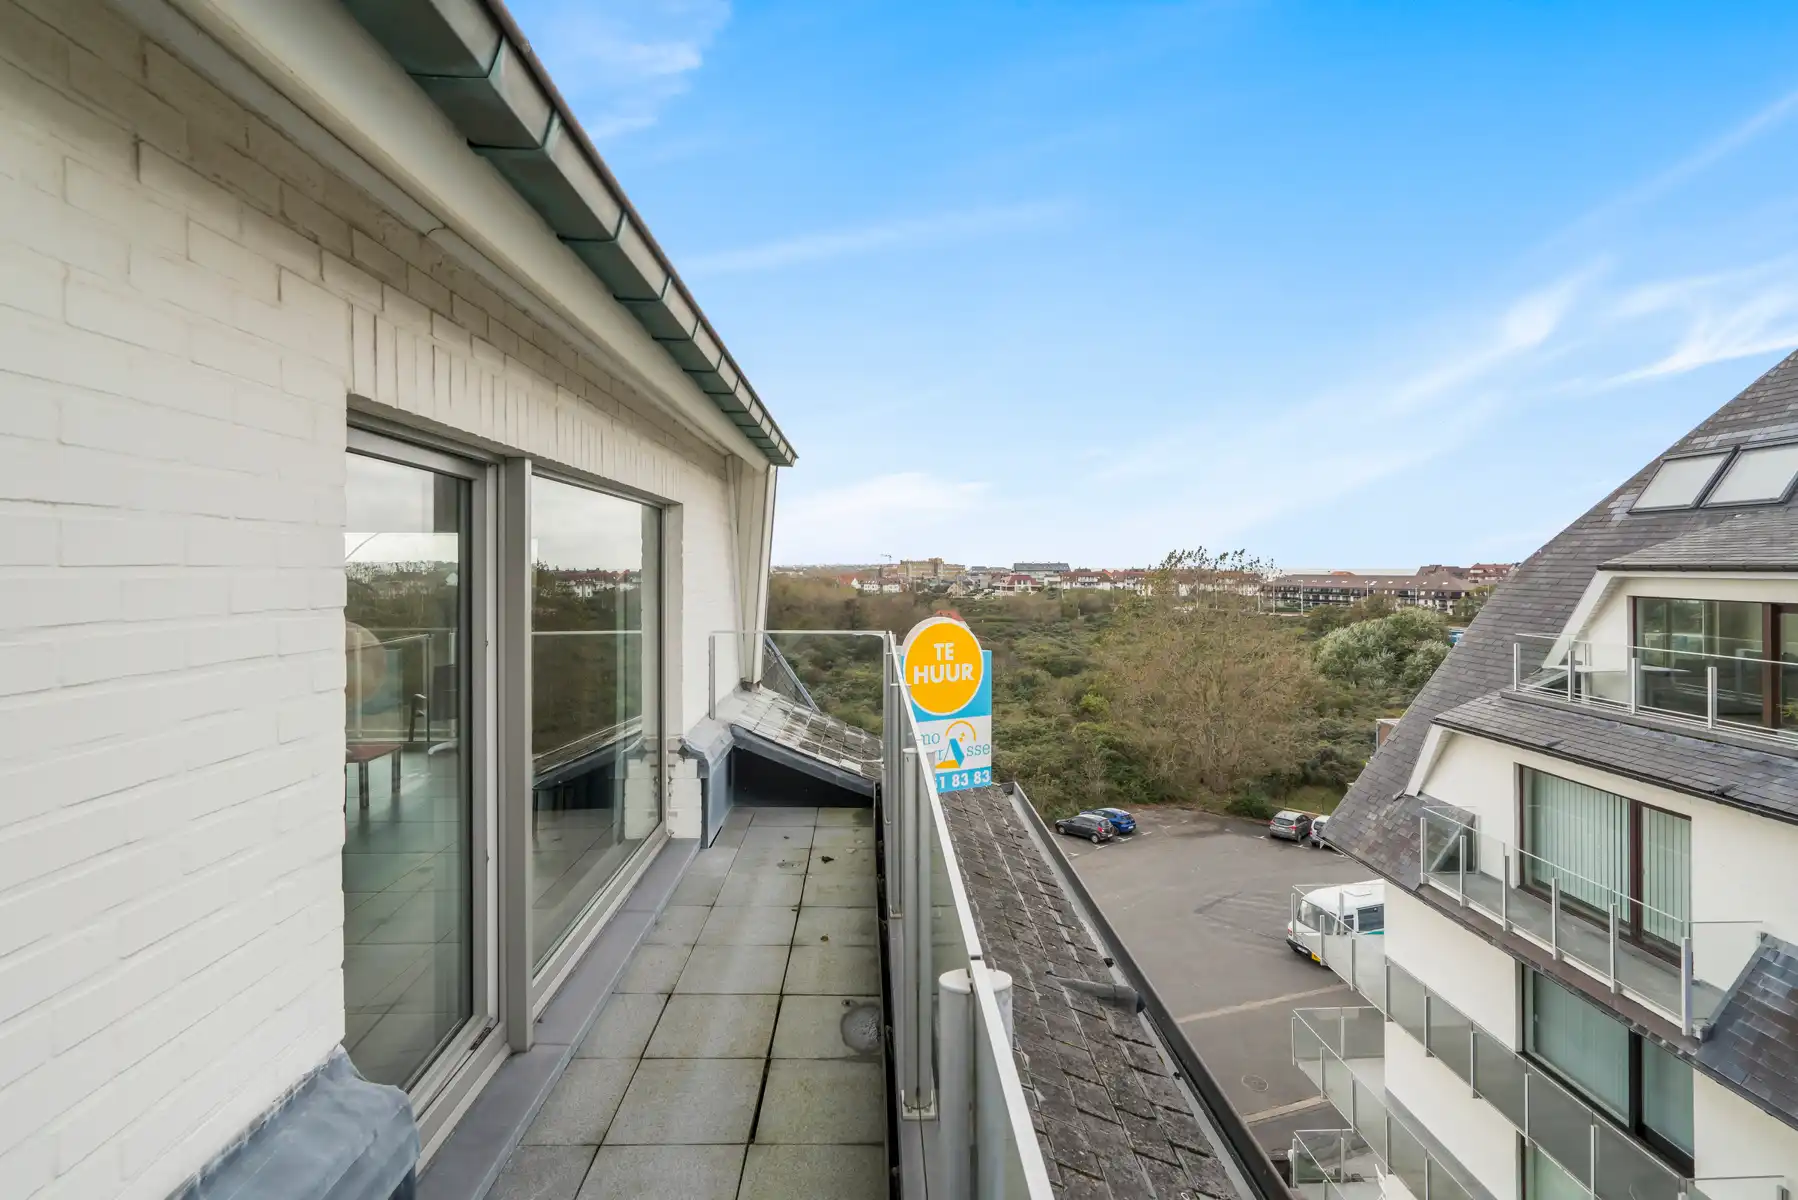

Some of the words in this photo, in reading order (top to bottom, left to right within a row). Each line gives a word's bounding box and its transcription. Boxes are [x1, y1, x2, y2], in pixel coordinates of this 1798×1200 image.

[933, 643, 955, 661] TE
[913, 663, 975, 685] HUUR
[951, 773, 969, 788] 83
[973, 769, 990, 785] 83
